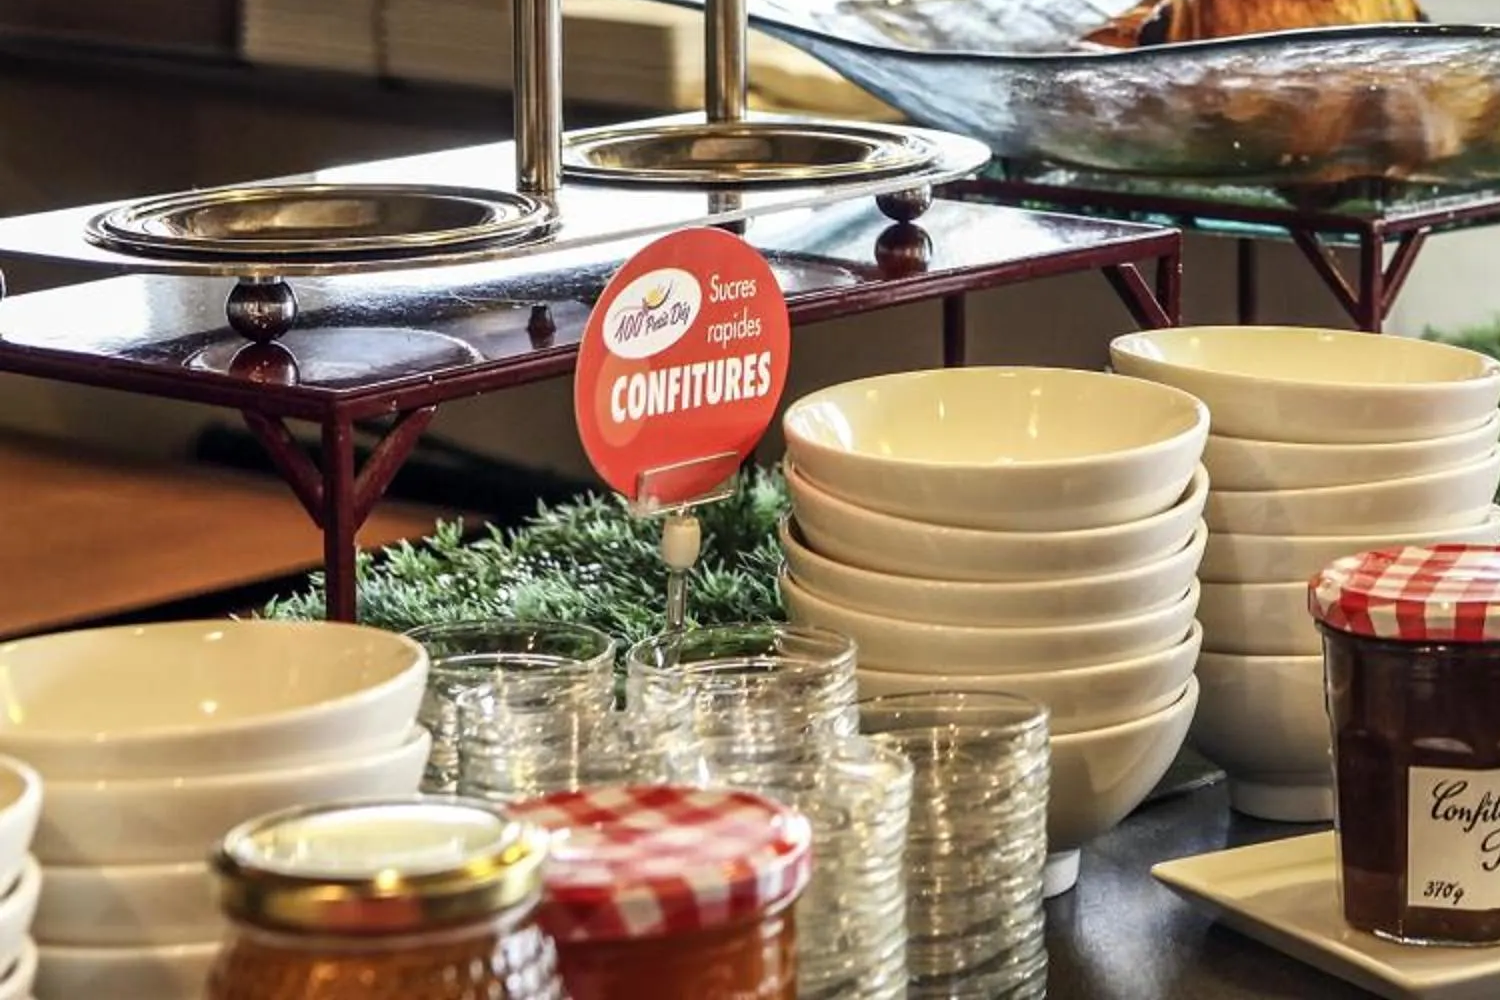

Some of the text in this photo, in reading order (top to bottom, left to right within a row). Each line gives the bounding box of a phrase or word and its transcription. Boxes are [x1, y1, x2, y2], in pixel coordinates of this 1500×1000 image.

[709, 274, 757, 304] Sucres
[707, 308, 761, 349] rapides
[610, 351, 772, 424] CONFITURES
[1423, 880, 1465, 905] 370g
